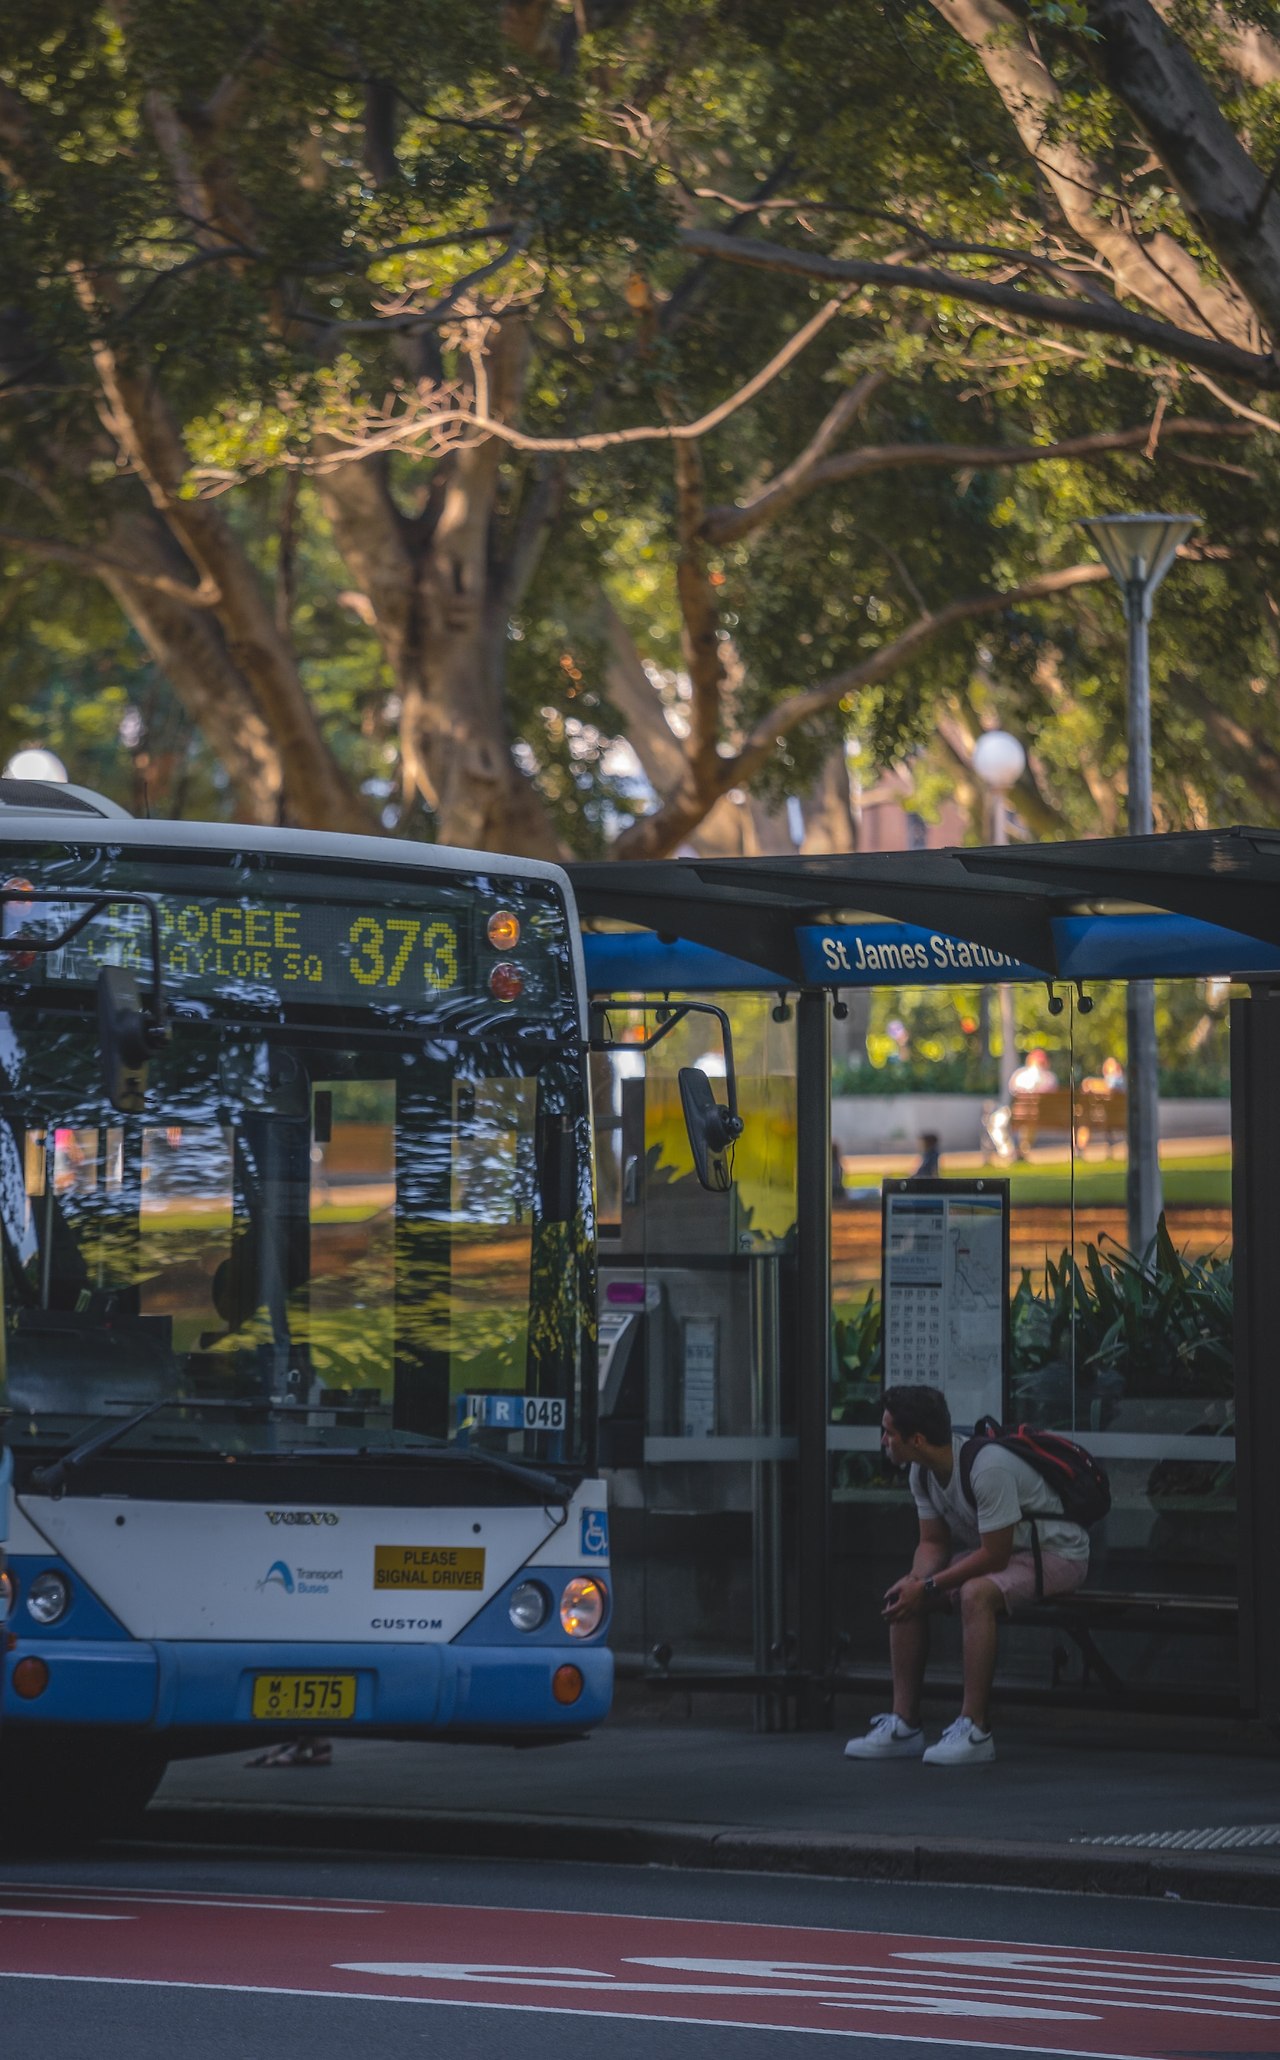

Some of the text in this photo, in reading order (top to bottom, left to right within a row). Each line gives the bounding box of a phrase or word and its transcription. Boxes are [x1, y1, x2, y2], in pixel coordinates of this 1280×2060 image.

[349, 917, 458, 989] 373
[821, 937, 851, 971] St
[855, 937, 929, 970] James
[161, 944, 272, 978] AYLOR
[283, 954, 323, 982] SQ
[496, 1401, 510, 1421] R
[526, 1400, 563, 1428] 048
[265, 1511, 340, 1526] VOLVO
[404, 1551, 458, 1566] PLEASE
[296, 1568, 343, 1582] Transport
[377, 1569, 483, 1585] SIGNAL DRIVER
[297, 1583, 329, 1594] Buses
[370, 1618, 443, 1630] CUSTOM
[294, 1680, 342, 1709] 1575
